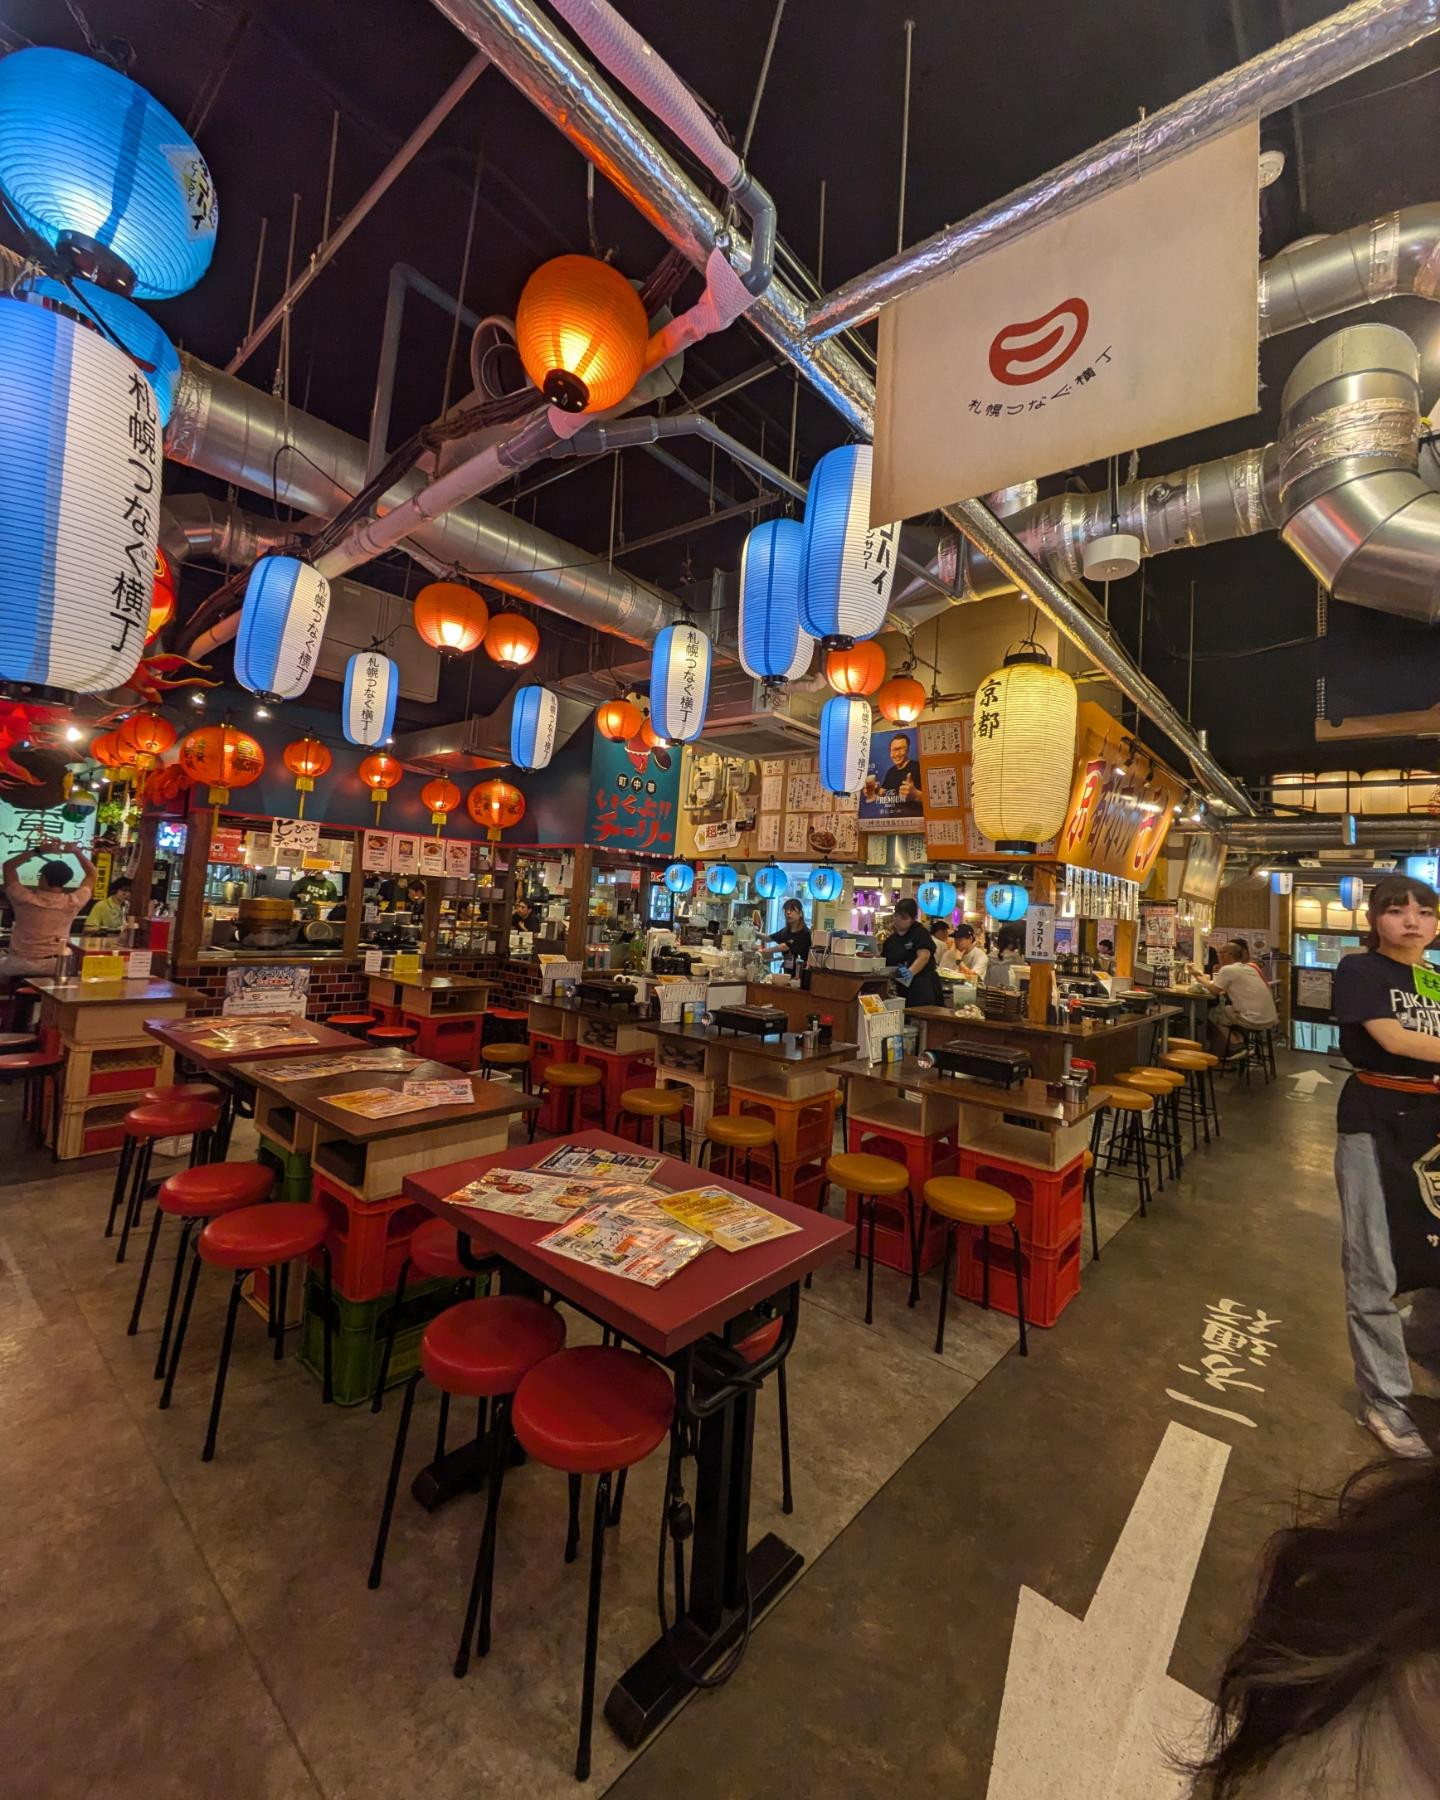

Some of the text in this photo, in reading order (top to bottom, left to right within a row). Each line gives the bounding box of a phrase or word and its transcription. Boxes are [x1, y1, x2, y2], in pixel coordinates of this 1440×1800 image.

[968, 345, 1112, 417] 札幌つなぐ横丁
[110, 372, 157, 652] 札幌つなぐ横丁
[295, 578, 328, 681] 札幌つなぐ横丁
[361, 657, 380, 731] 札幌つなぐ横丁
[680, 631, 700, 723] 札幌つなぐ横丁
[978, 678, 1002, 739] 京都
[592, 810, 673, 848] チーリー
[1036, 920, 1044, 950] タコハイ
